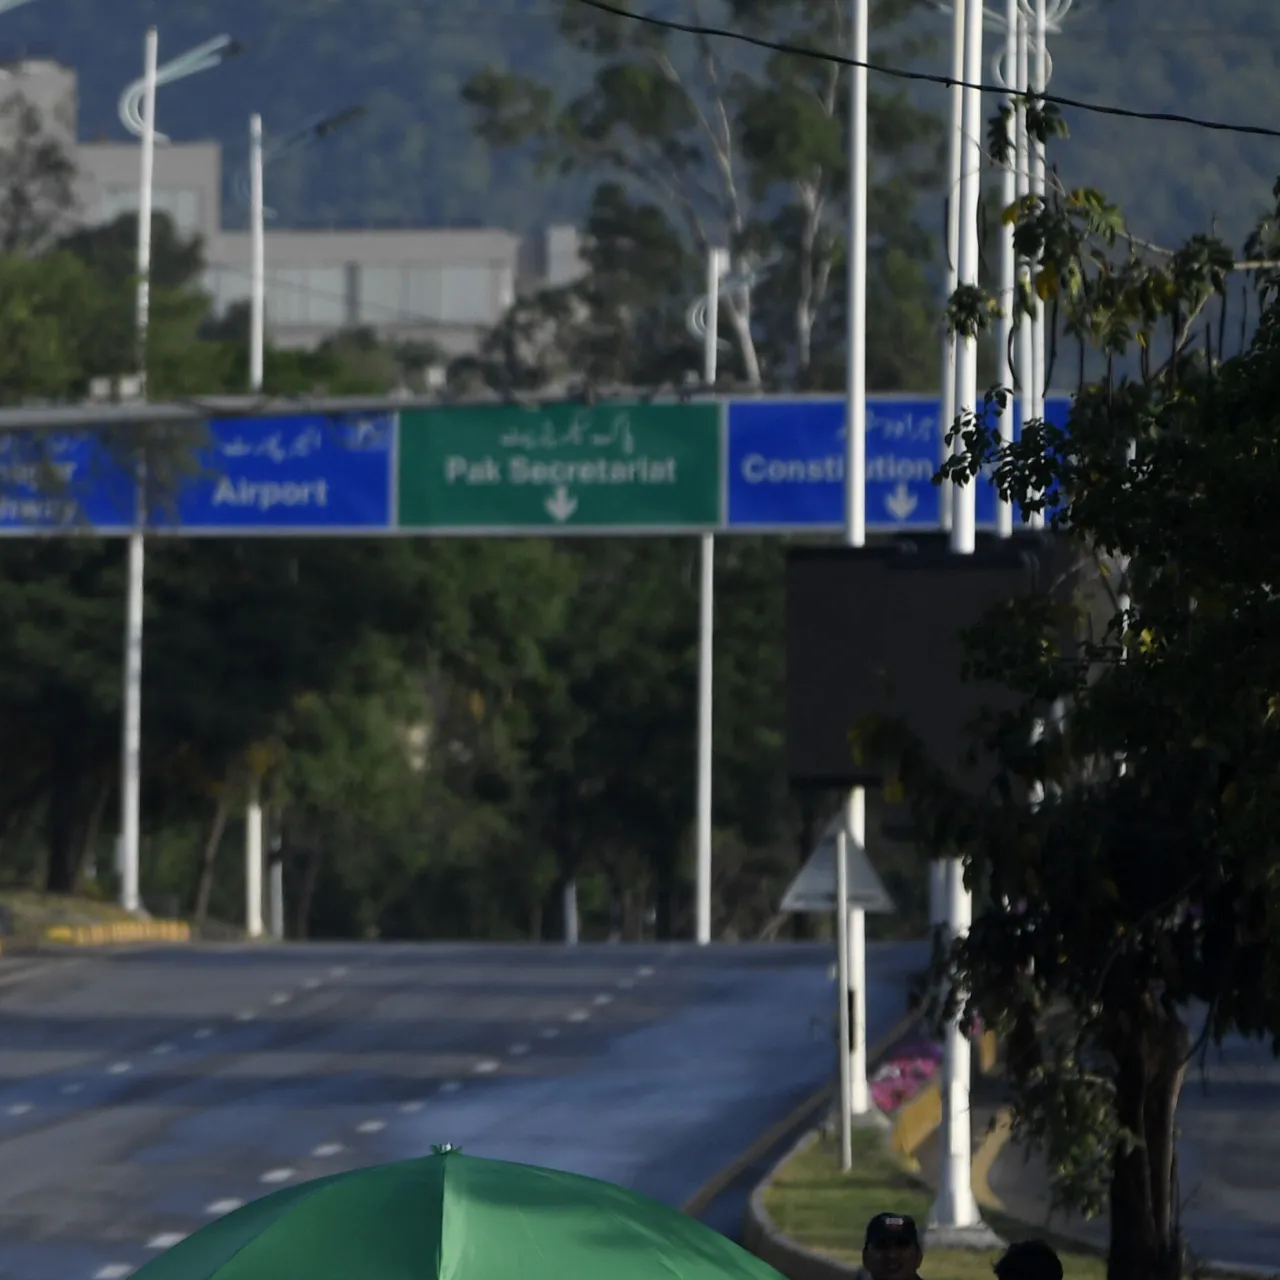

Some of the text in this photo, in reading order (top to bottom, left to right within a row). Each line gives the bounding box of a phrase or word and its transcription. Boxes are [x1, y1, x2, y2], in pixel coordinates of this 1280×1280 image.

[444, 455, 677, 485] Pak Secretariat
[740, 452, 934, 485] Constition
[212, 476, 329, 511] Airport
